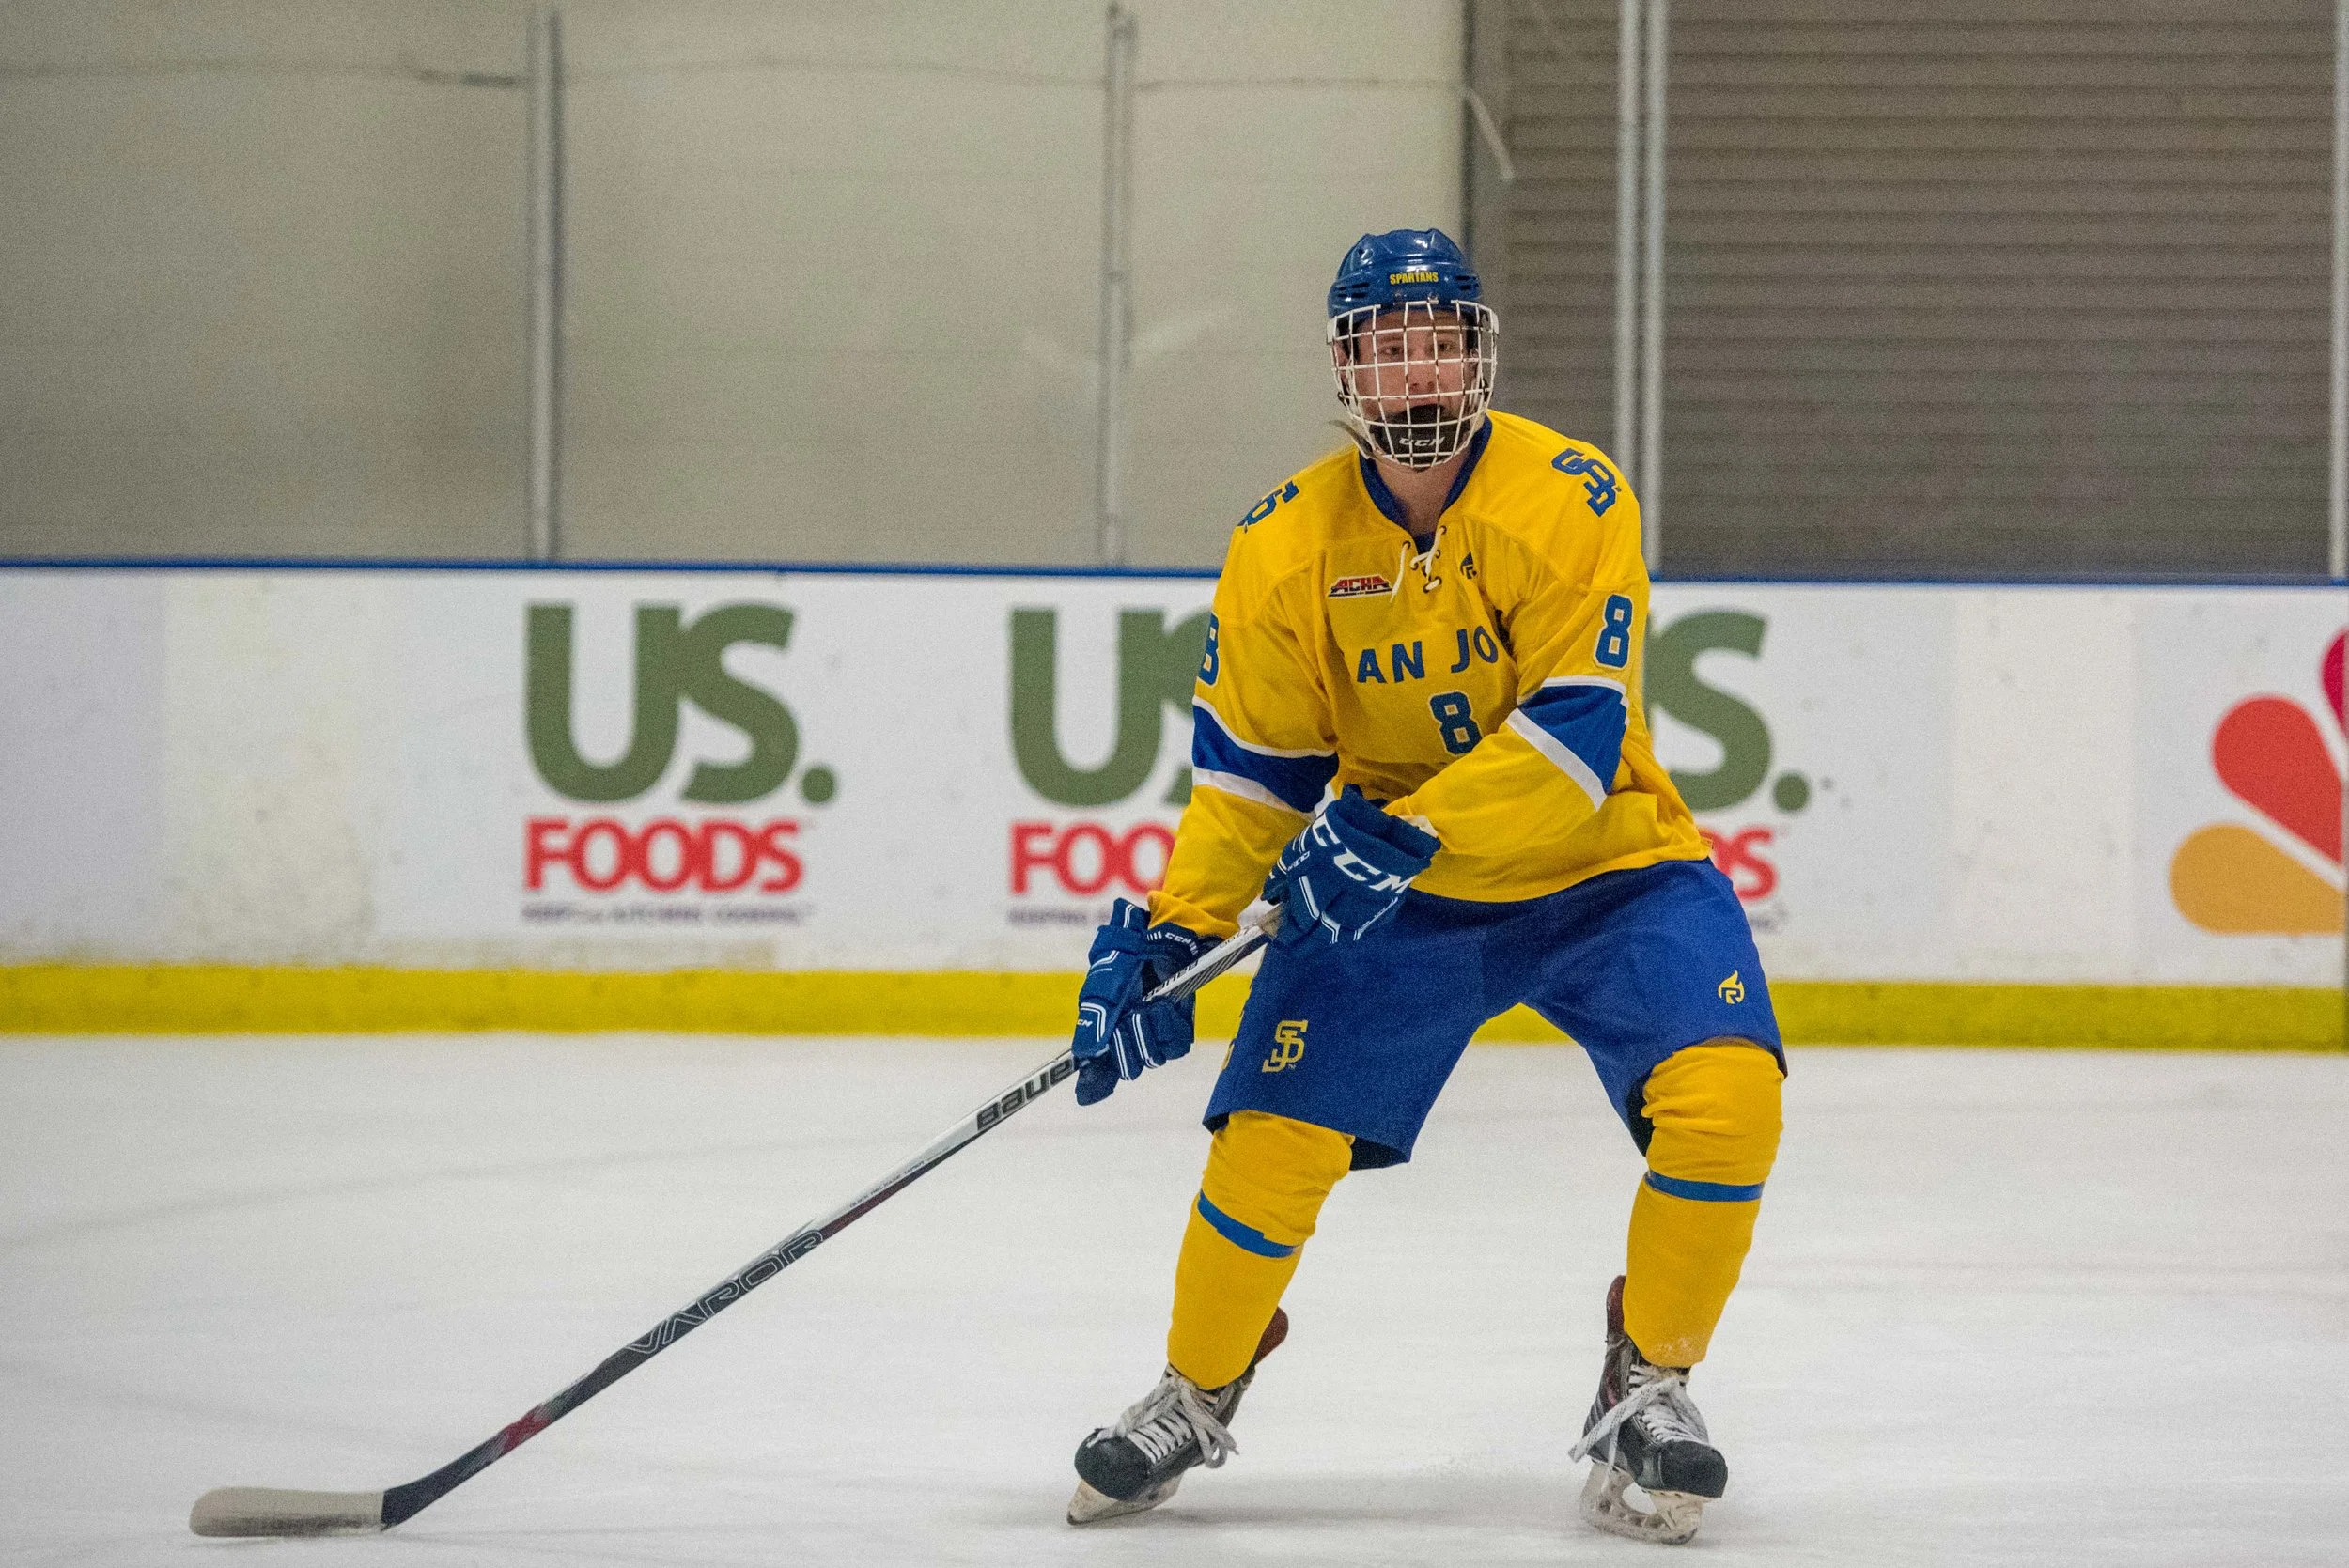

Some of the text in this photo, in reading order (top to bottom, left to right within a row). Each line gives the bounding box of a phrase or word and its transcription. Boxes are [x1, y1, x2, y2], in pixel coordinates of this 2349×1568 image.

[1390, 272, 1439, 284] SPARTANS
[1357, 625, 1499, 684] AN JO
[1594, 593, 1633, 669] 8
[521, 601, 838, 805] US.
[1428, 690, 1484, 756] 8
[1642, 610, 1811, 814] S.
[523, 816, 805, 895] FOODS
[1010, 822, 1177, 896] FOO
[1312, 812, 1415, 893] CCM
[1077, 1018, 1093, 1027] CM
